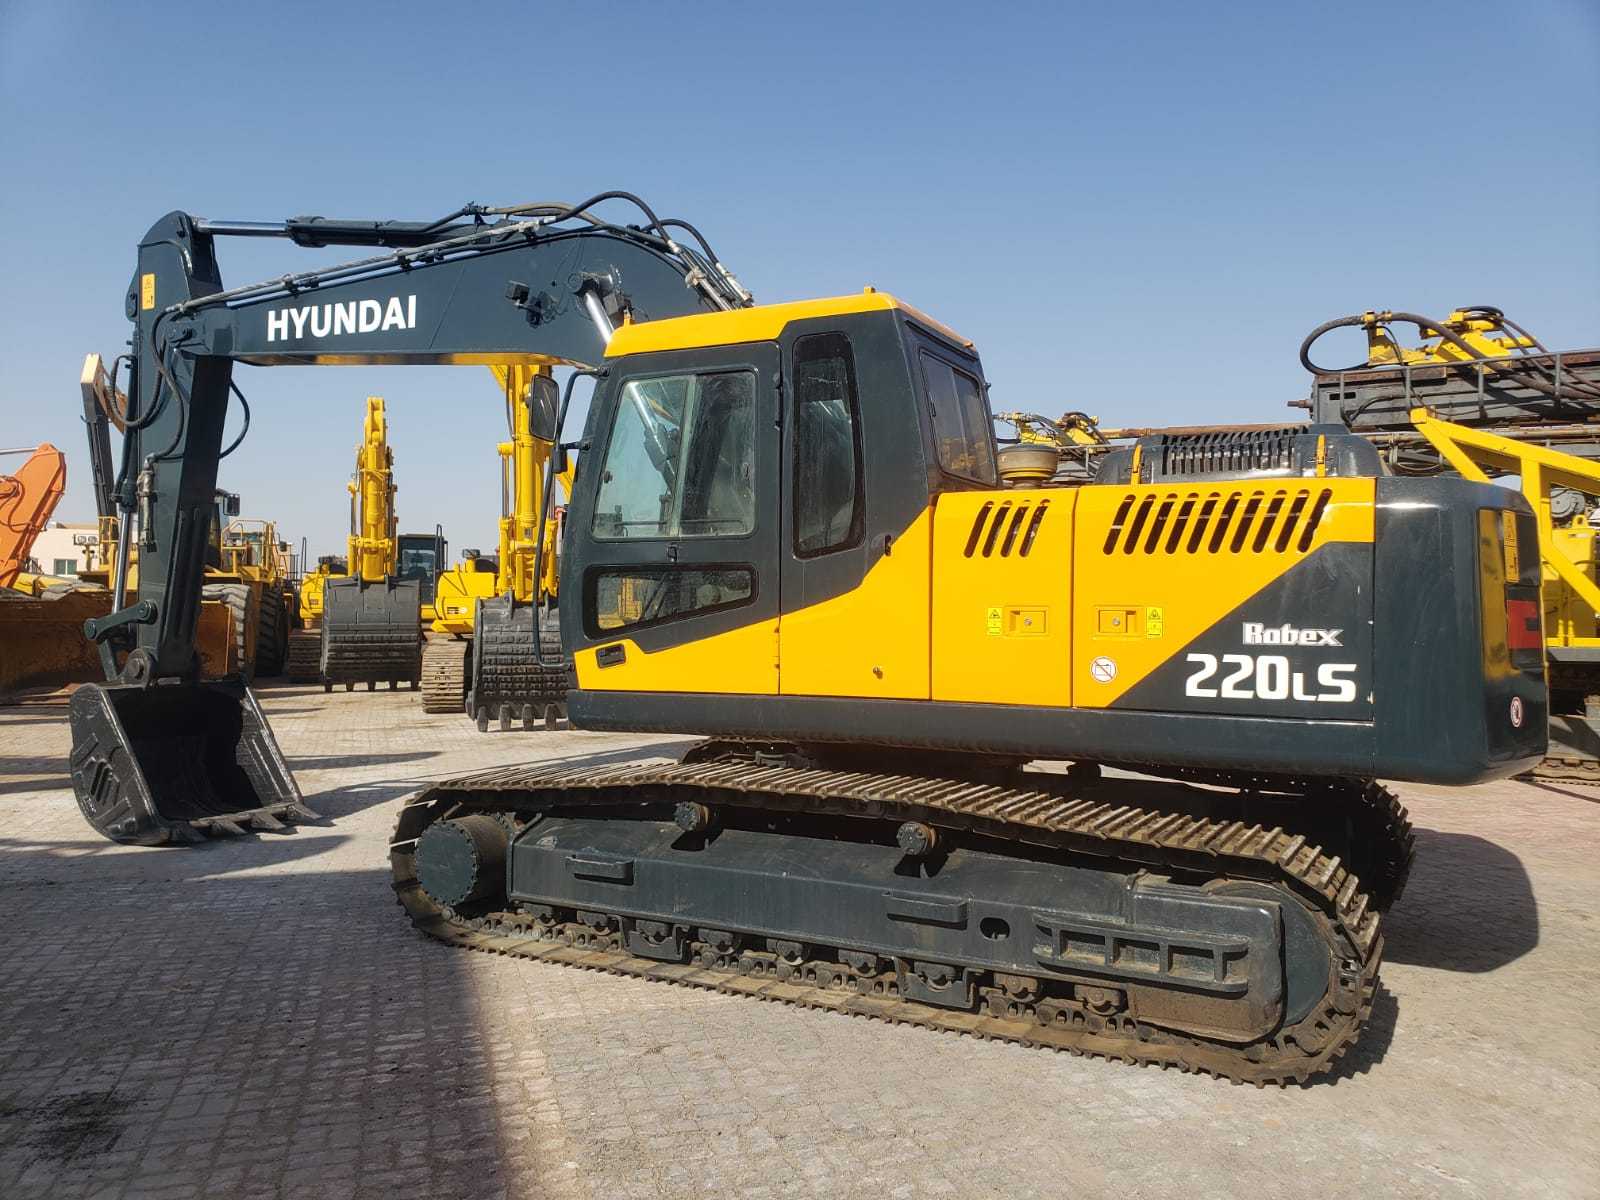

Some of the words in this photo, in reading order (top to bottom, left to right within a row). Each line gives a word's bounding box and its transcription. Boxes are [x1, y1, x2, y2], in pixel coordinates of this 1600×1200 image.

[267, 294, 417, 342] HYUNDAI
[1242, 621, 1344, 647] Robex
[1185, 653, 1357, 703] 220LS
